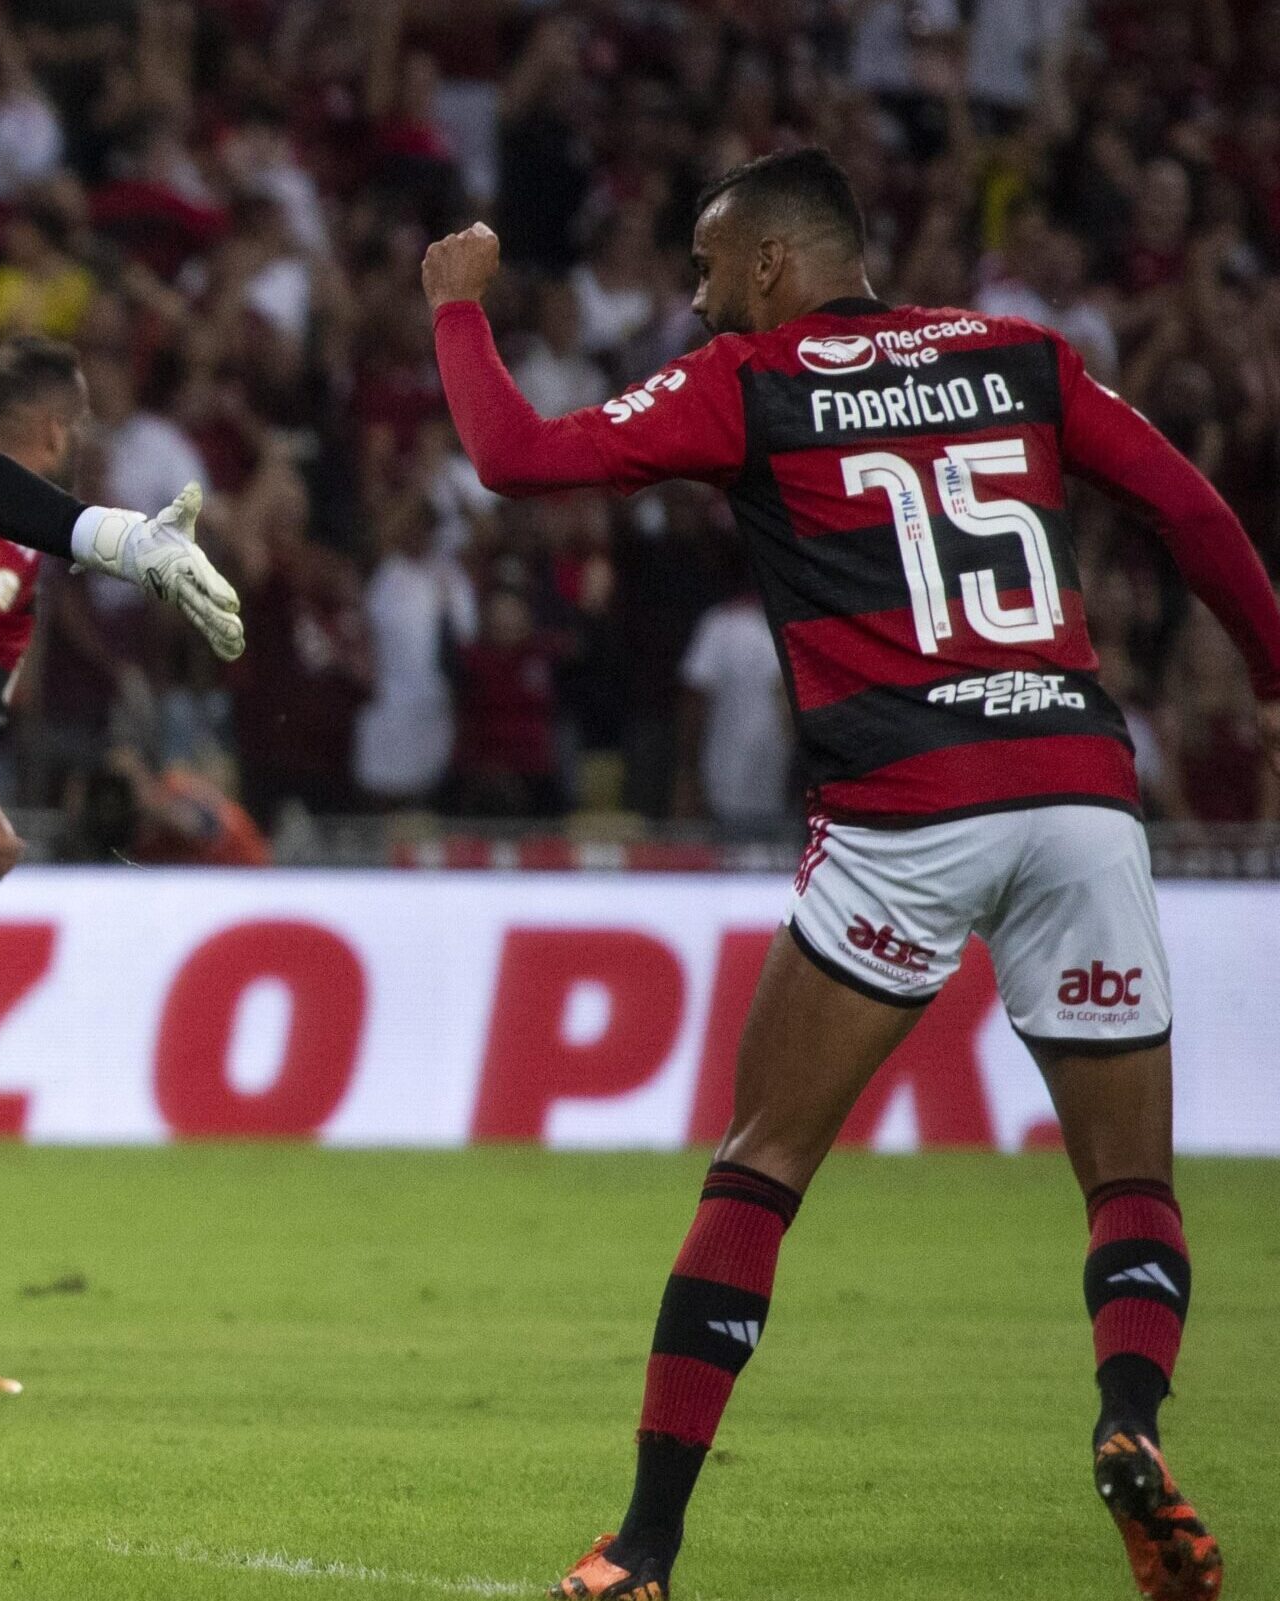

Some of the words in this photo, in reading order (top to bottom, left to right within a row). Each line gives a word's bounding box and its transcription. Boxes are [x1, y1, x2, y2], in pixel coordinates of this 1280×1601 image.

[875, 316, 988, 352] mercado
[888, 346, 939, 370] livre
[811, 375, 980, 433] FABRÍCIO
[981, 372, 1025, 414] B.
[944, 464, 962, 497] TIM
[898, 489, 917, 523] TIM
[839, 438, 1065, 656] 15
[927, 670, 1066, 705] ASSIST
[983, 687, 1086, 717] CARD
[846, 913, 937, 973] abc
[1057, 959, 1143, 1008] abc
[152, 916, 366, 1143] O
[1056, 1008, 1075, 1021] da
